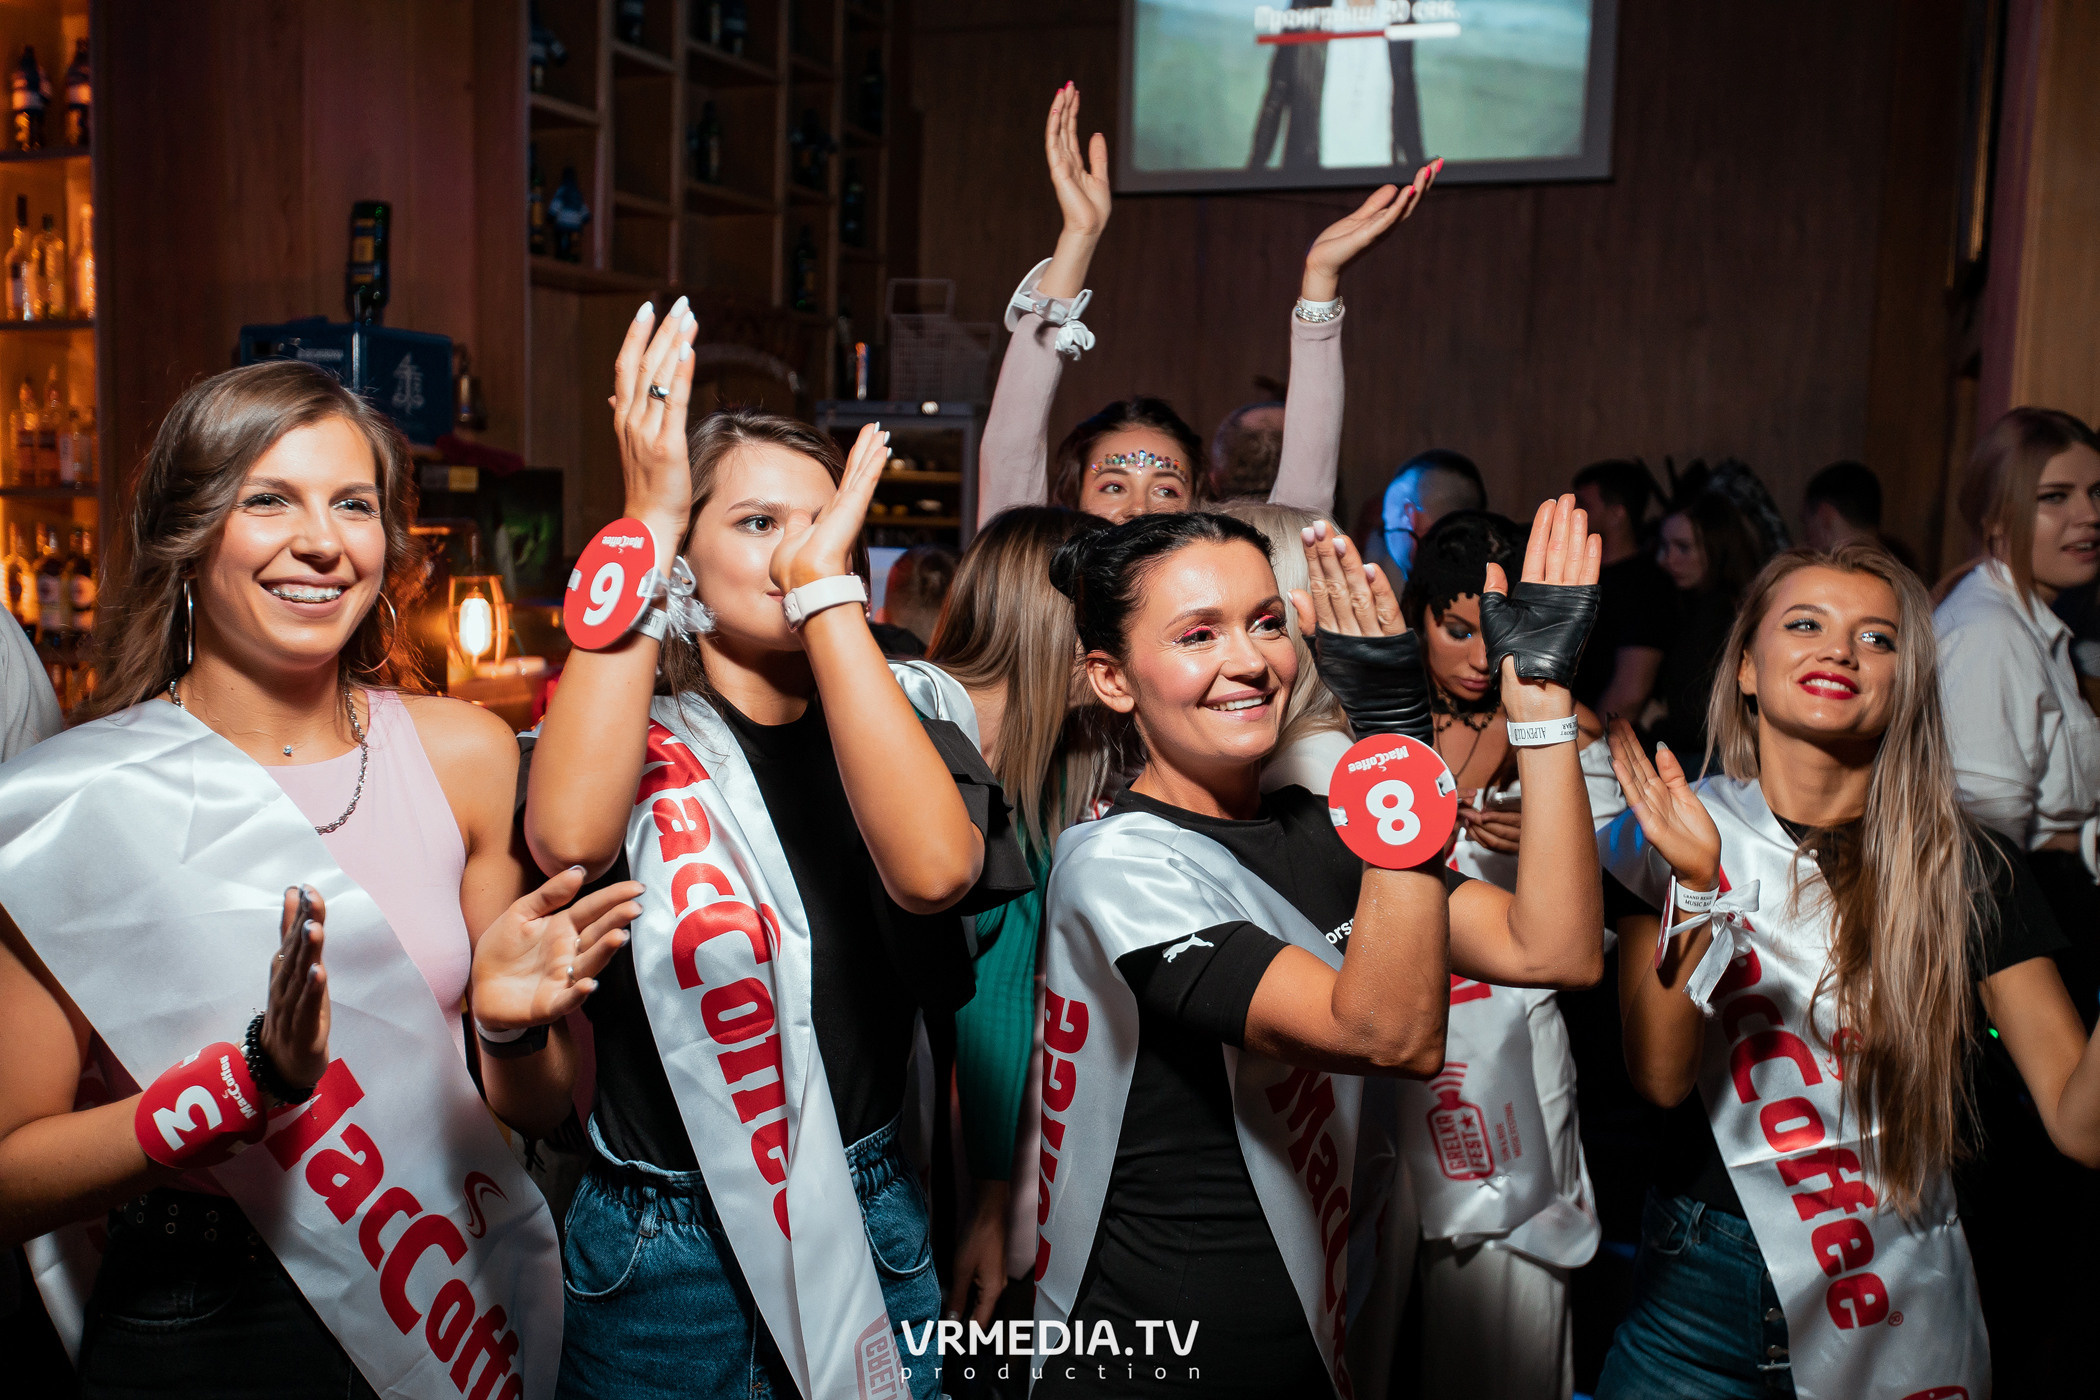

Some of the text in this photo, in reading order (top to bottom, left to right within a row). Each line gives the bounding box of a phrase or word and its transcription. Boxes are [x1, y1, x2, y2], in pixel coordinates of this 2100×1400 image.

[1347, 745, 1410, 774] MacCoffee
[1365, 779, 1421, 846] 8
[1685, 899, 1703, 907] MUSIC
[219, 1054, 258, 1120] MacCoffee
[152, 1085, 223, 1151] 3
[1461, 1132, 1486, 1168] FEST
